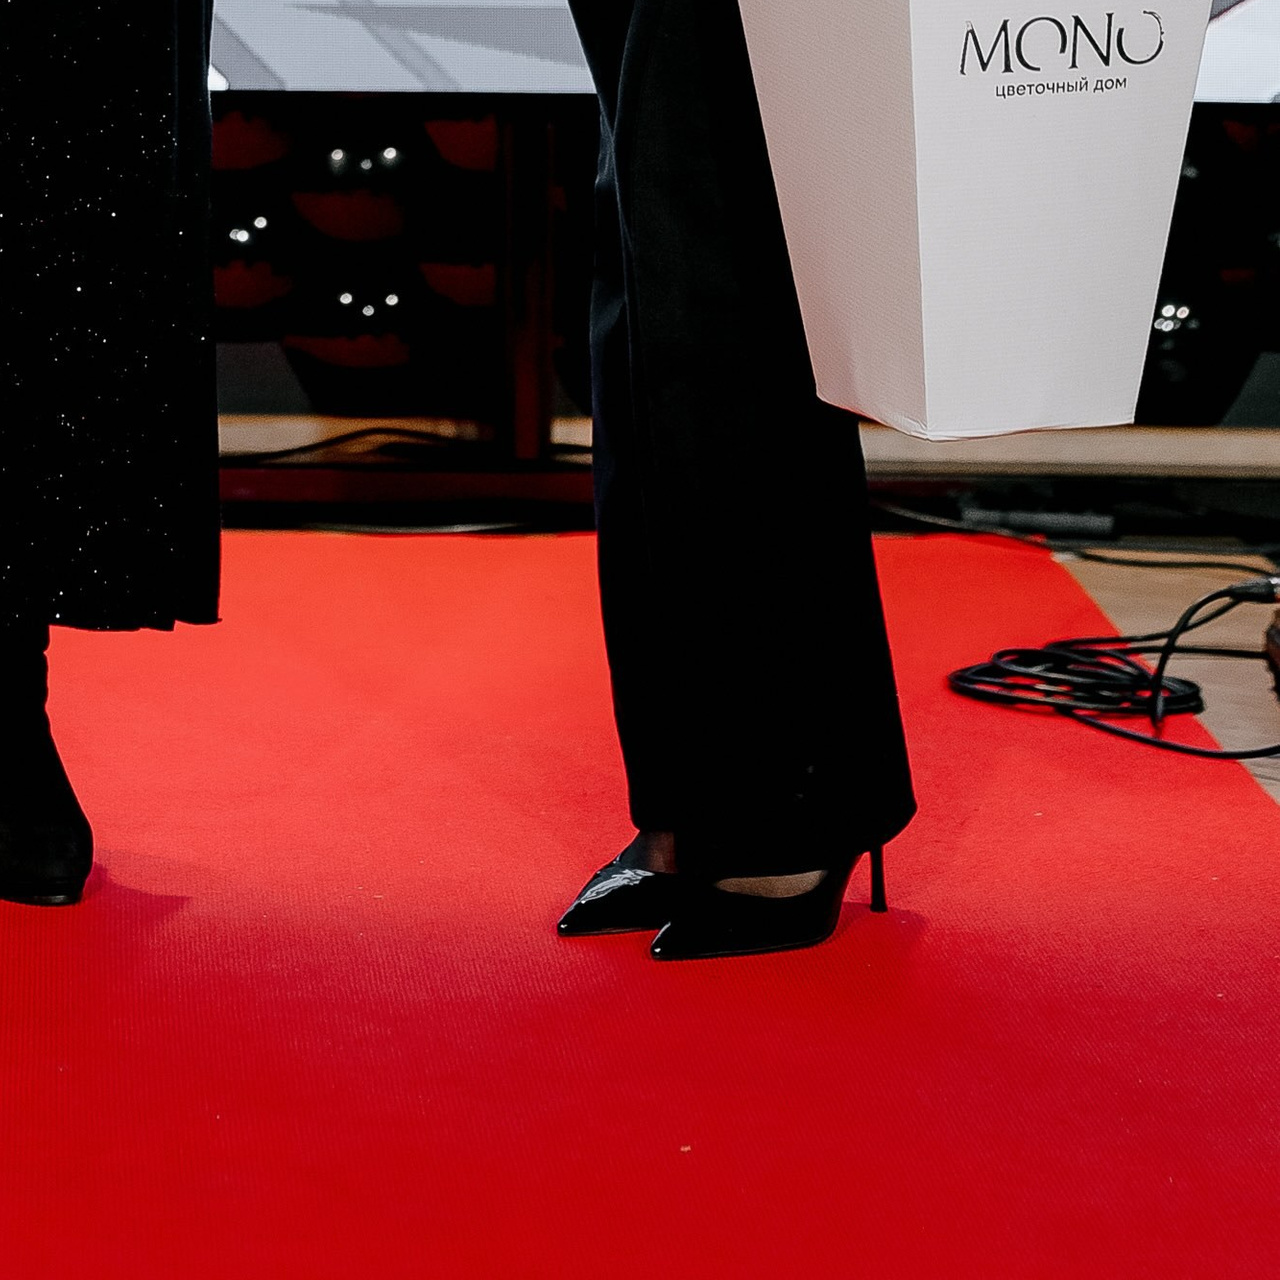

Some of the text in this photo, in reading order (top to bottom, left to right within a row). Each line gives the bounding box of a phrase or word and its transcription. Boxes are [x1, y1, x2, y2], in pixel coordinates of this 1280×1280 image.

[959, 10, 1165, 75] MONO
[996, 77, 1127, 97] цветочный дом
